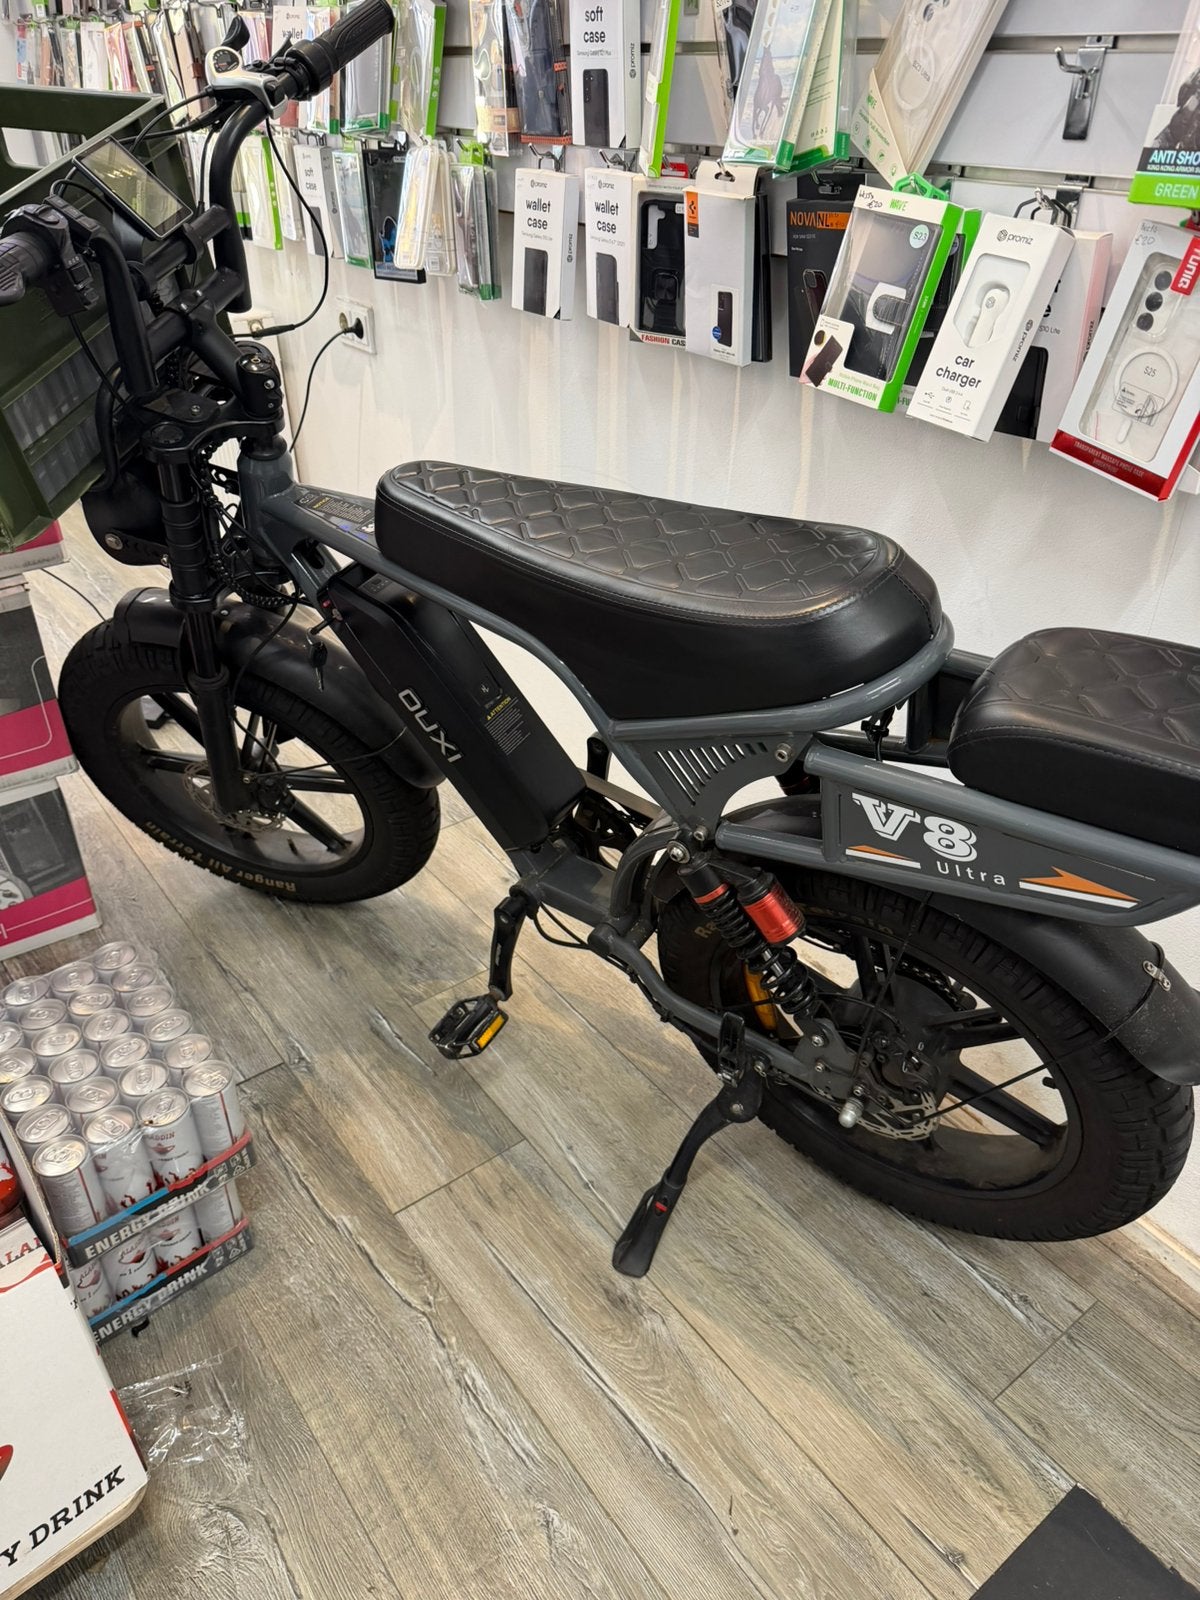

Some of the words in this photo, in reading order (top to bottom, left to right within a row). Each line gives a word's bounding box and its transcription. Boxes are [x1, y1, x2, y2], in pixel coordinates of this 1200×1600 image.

[585, 6, 603, 22] soft
[583, 31, 606, 43] case
[1149, 149, 1177, 164] ANTI
[1155, 183, 1199, 200] GREEN
[526, 198, 551, 213] wallet
[595, 200, 619, 216] wallet
[527, 217, 548, 230] case
[597, 221, 617, 234] case
[913, 231, 927, 241] S23
[1006, 232, 1034, 246] promiz
[641, 334, 670, 345] FASHION
[671, 339, 686, 347] CAS
[1012, 330, 1027, 362] promiz
[955, 354, 975, 369] car
[935, 366, 982, 390] charger
[1143, 365, 1158, 378] S25
[827, 377, 878, 402] MULTI-FUNCTION
[1074, 440, 1102, 458] TRANSPARENT
[398, 689, 462, 763] OUXI
[851, 792, 978, 862] V8
[145, 821, 204, 864] Terrain
[208, 857, 233, 873] All
[936, 860, 1006, 886] Ultra
[236, 869, 297, 893] Ranger
[84, 1215, 151, 1260] ENERGY
[93, 1297, 151, 1343] ENERGY
[157, 1263, 208, 1300] DRINK
[29, 1464, 125, 1550] DRINK
